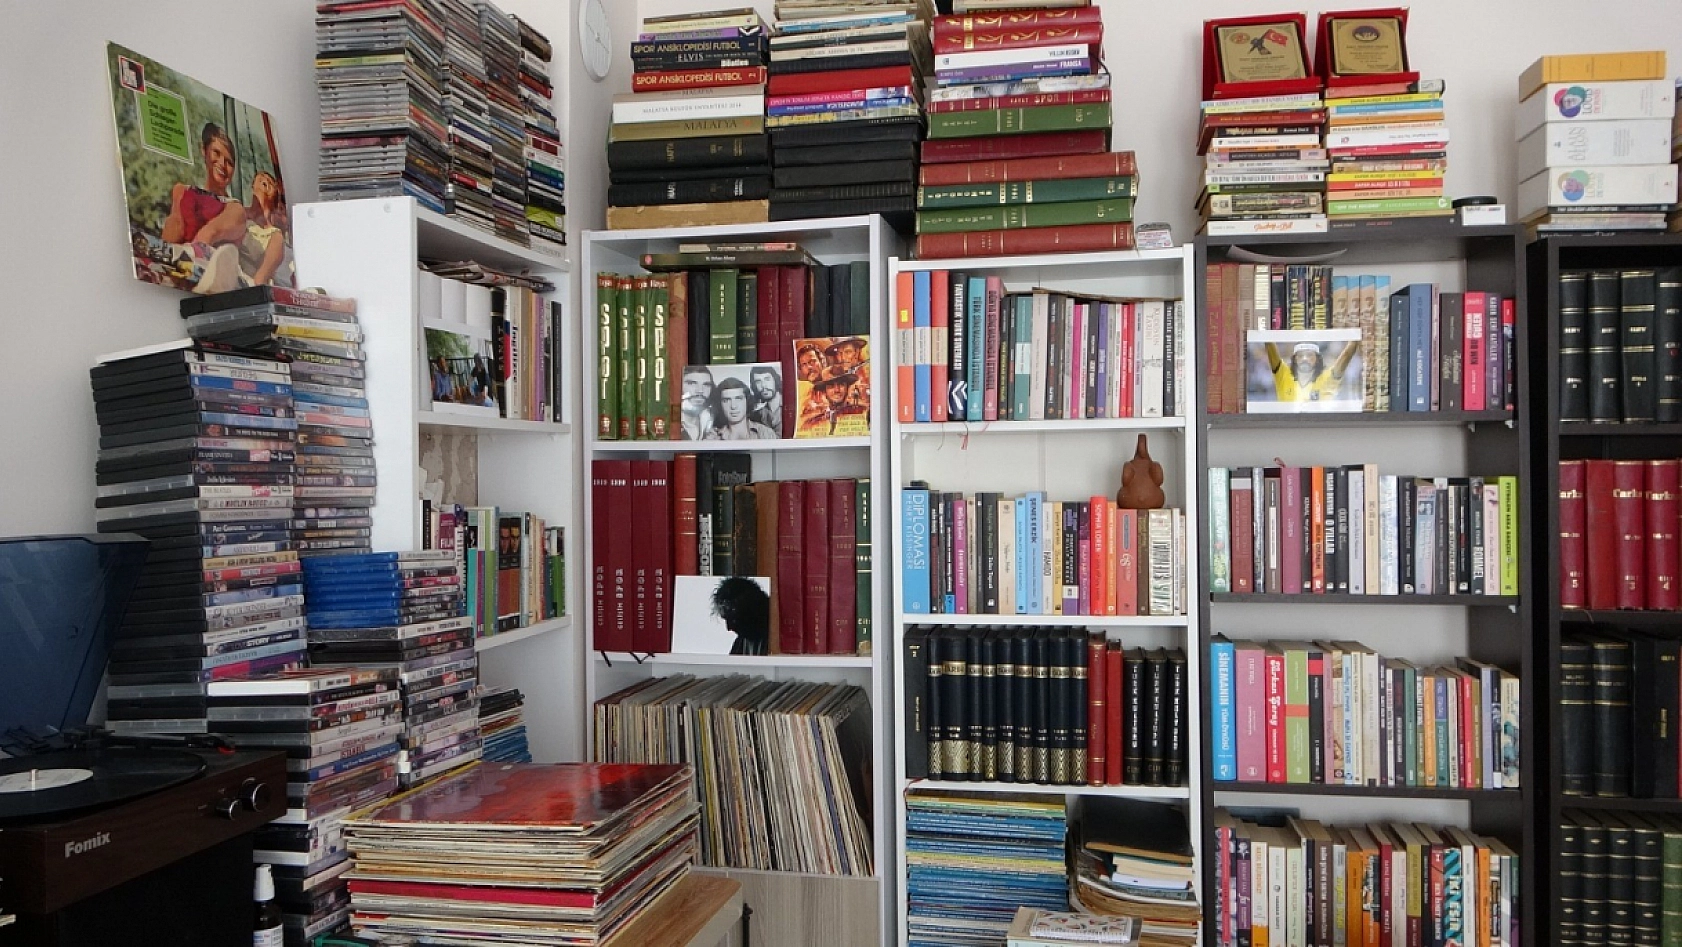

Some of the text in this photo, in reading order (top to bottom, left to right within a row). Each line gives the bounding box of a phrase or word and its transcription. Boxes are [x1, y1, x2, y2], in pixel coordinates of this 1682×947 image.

[713, 41, 741, 50] FUTBOL
[677, 53, 704, 62] ELVIS
[715, 72, 743, 81] FUTBOL
[683, 120, 738, 131] MALATYA
[911, 494, 926, 570] DİPLOMASİ
[1094, 530, 1102, 552] LOREN
[1218, 652, 1231, 705] SİNEMANIN
[64, 830, 112, 858] Fomix
